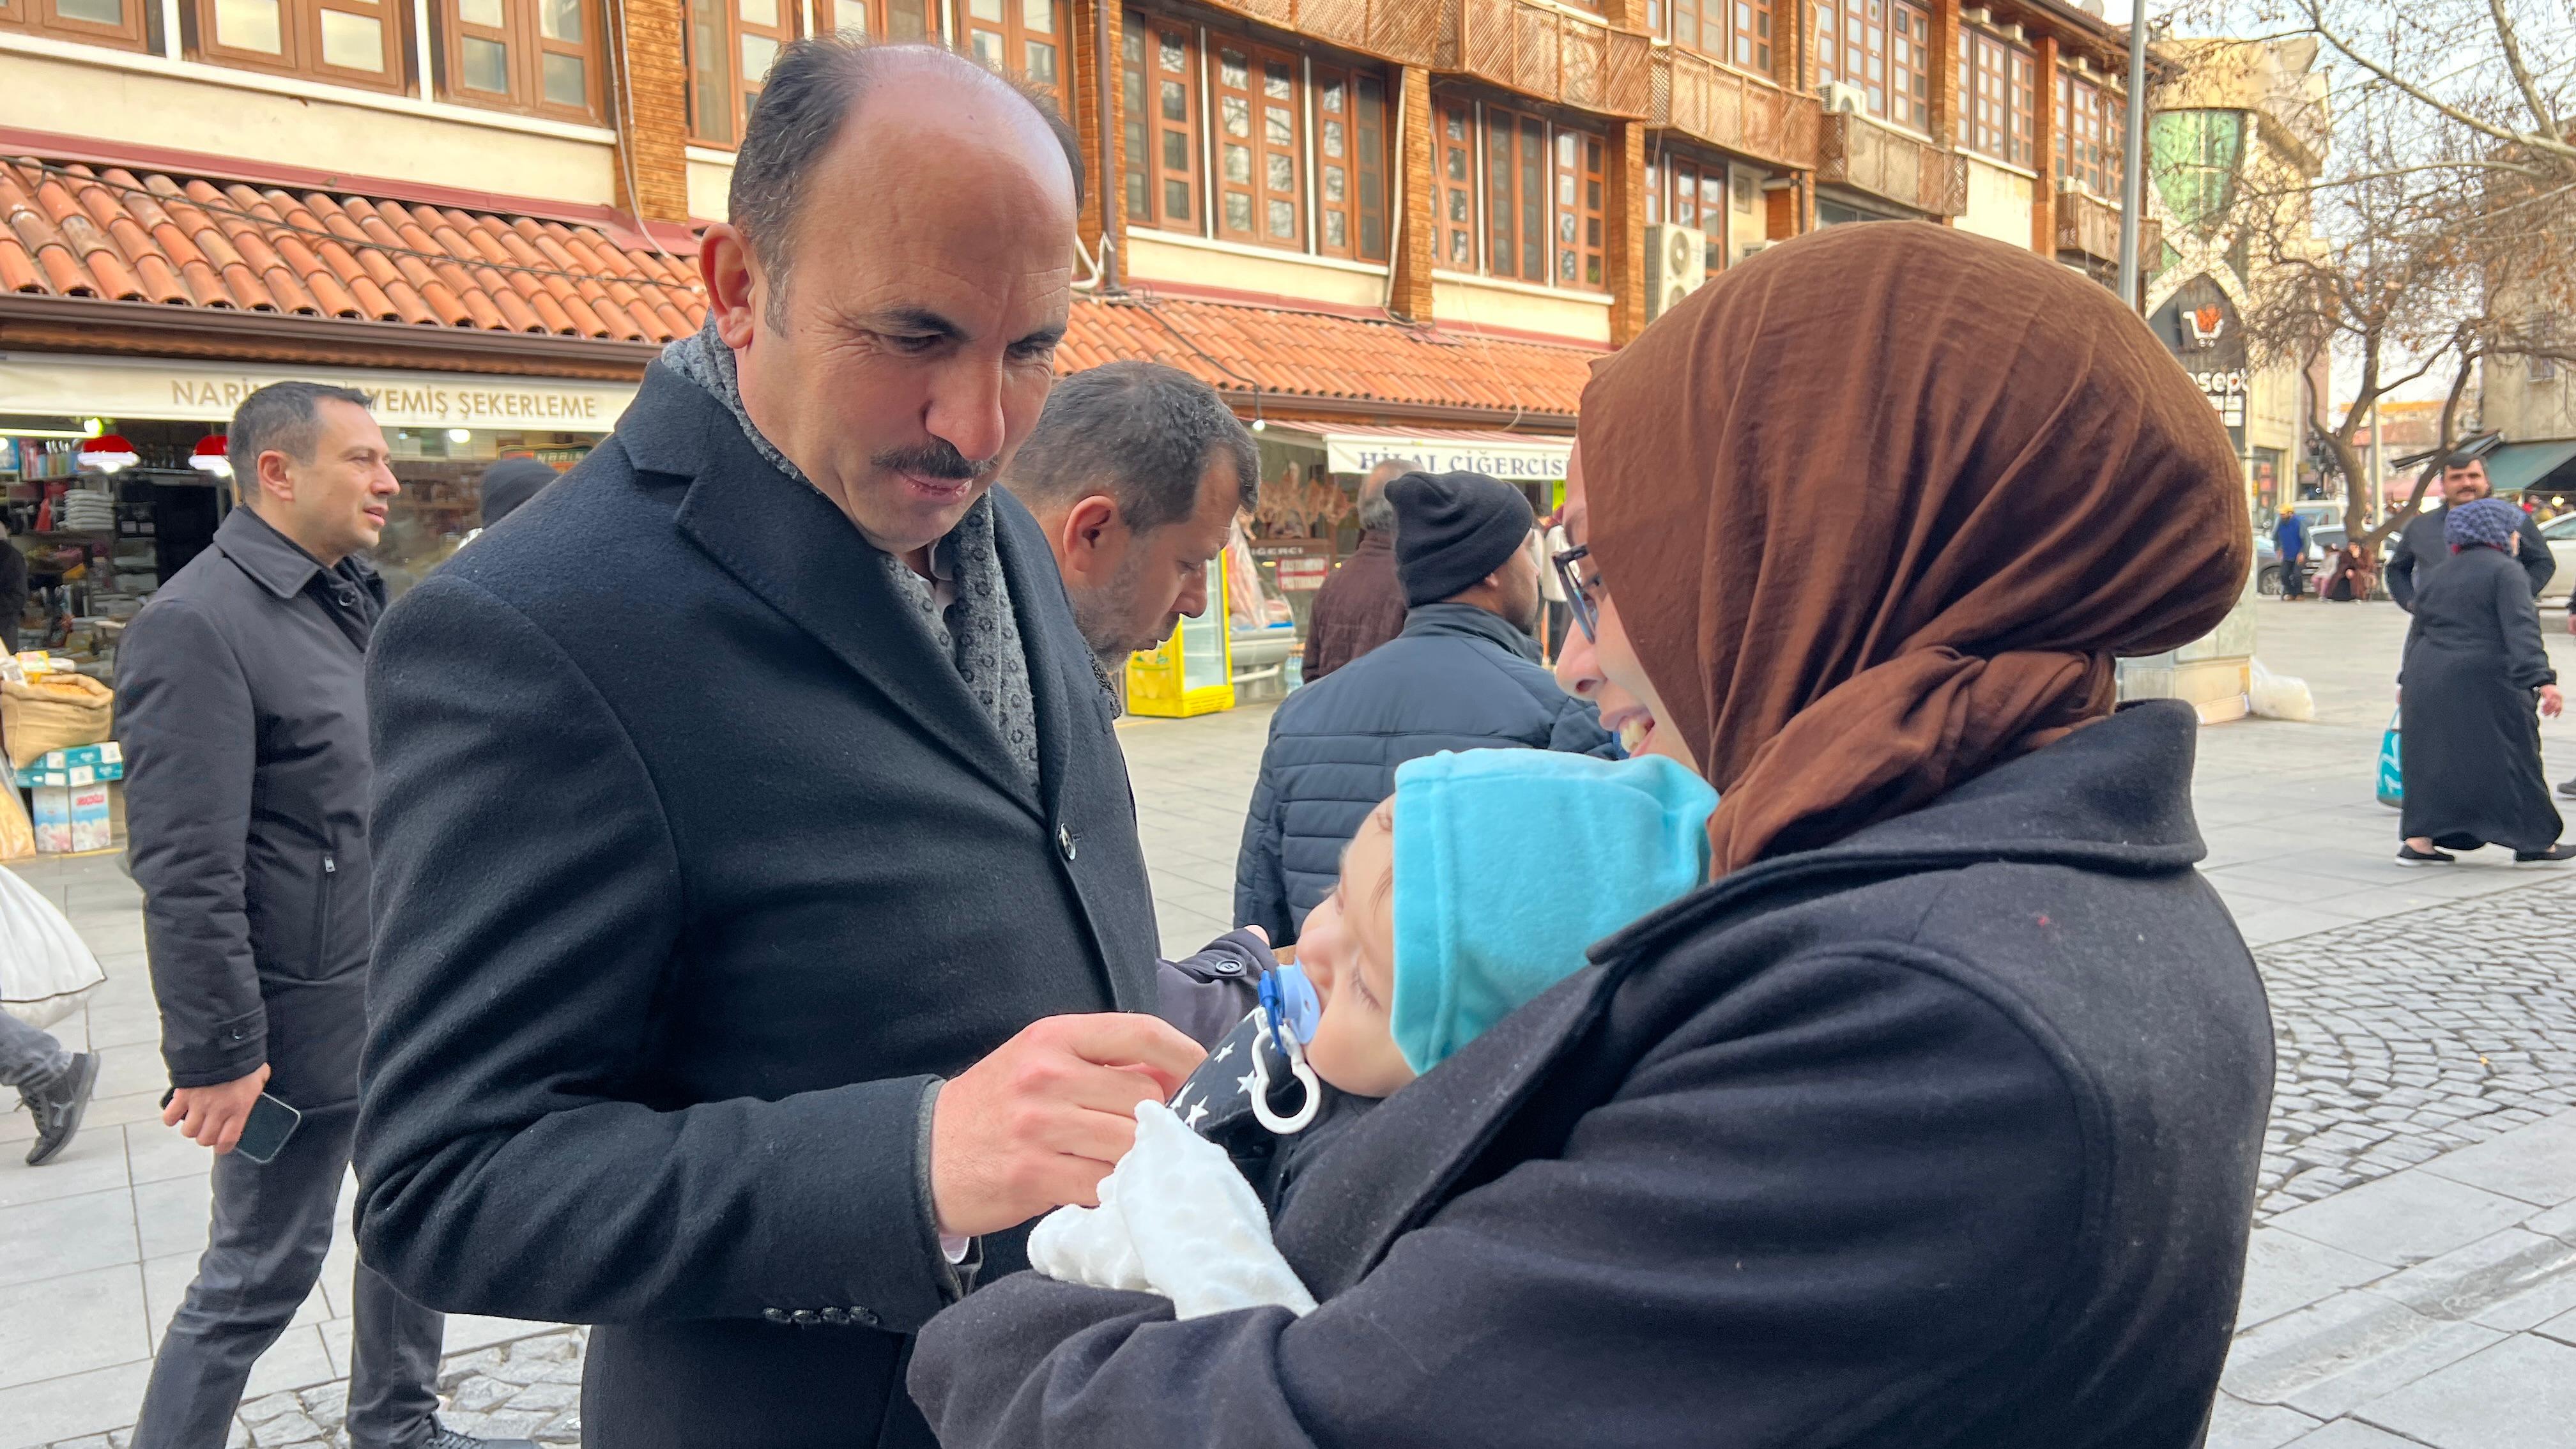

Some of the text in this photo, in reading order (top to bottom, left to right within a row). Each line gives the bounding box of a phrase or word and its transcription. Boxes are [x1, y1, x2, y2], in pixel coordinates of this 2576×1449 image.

[171, 377, 260, 408] NARİ
[457, 390, 598, 420] ŞEKERLEME
[1448, 449, 1570, 476] CİĞERCİS
